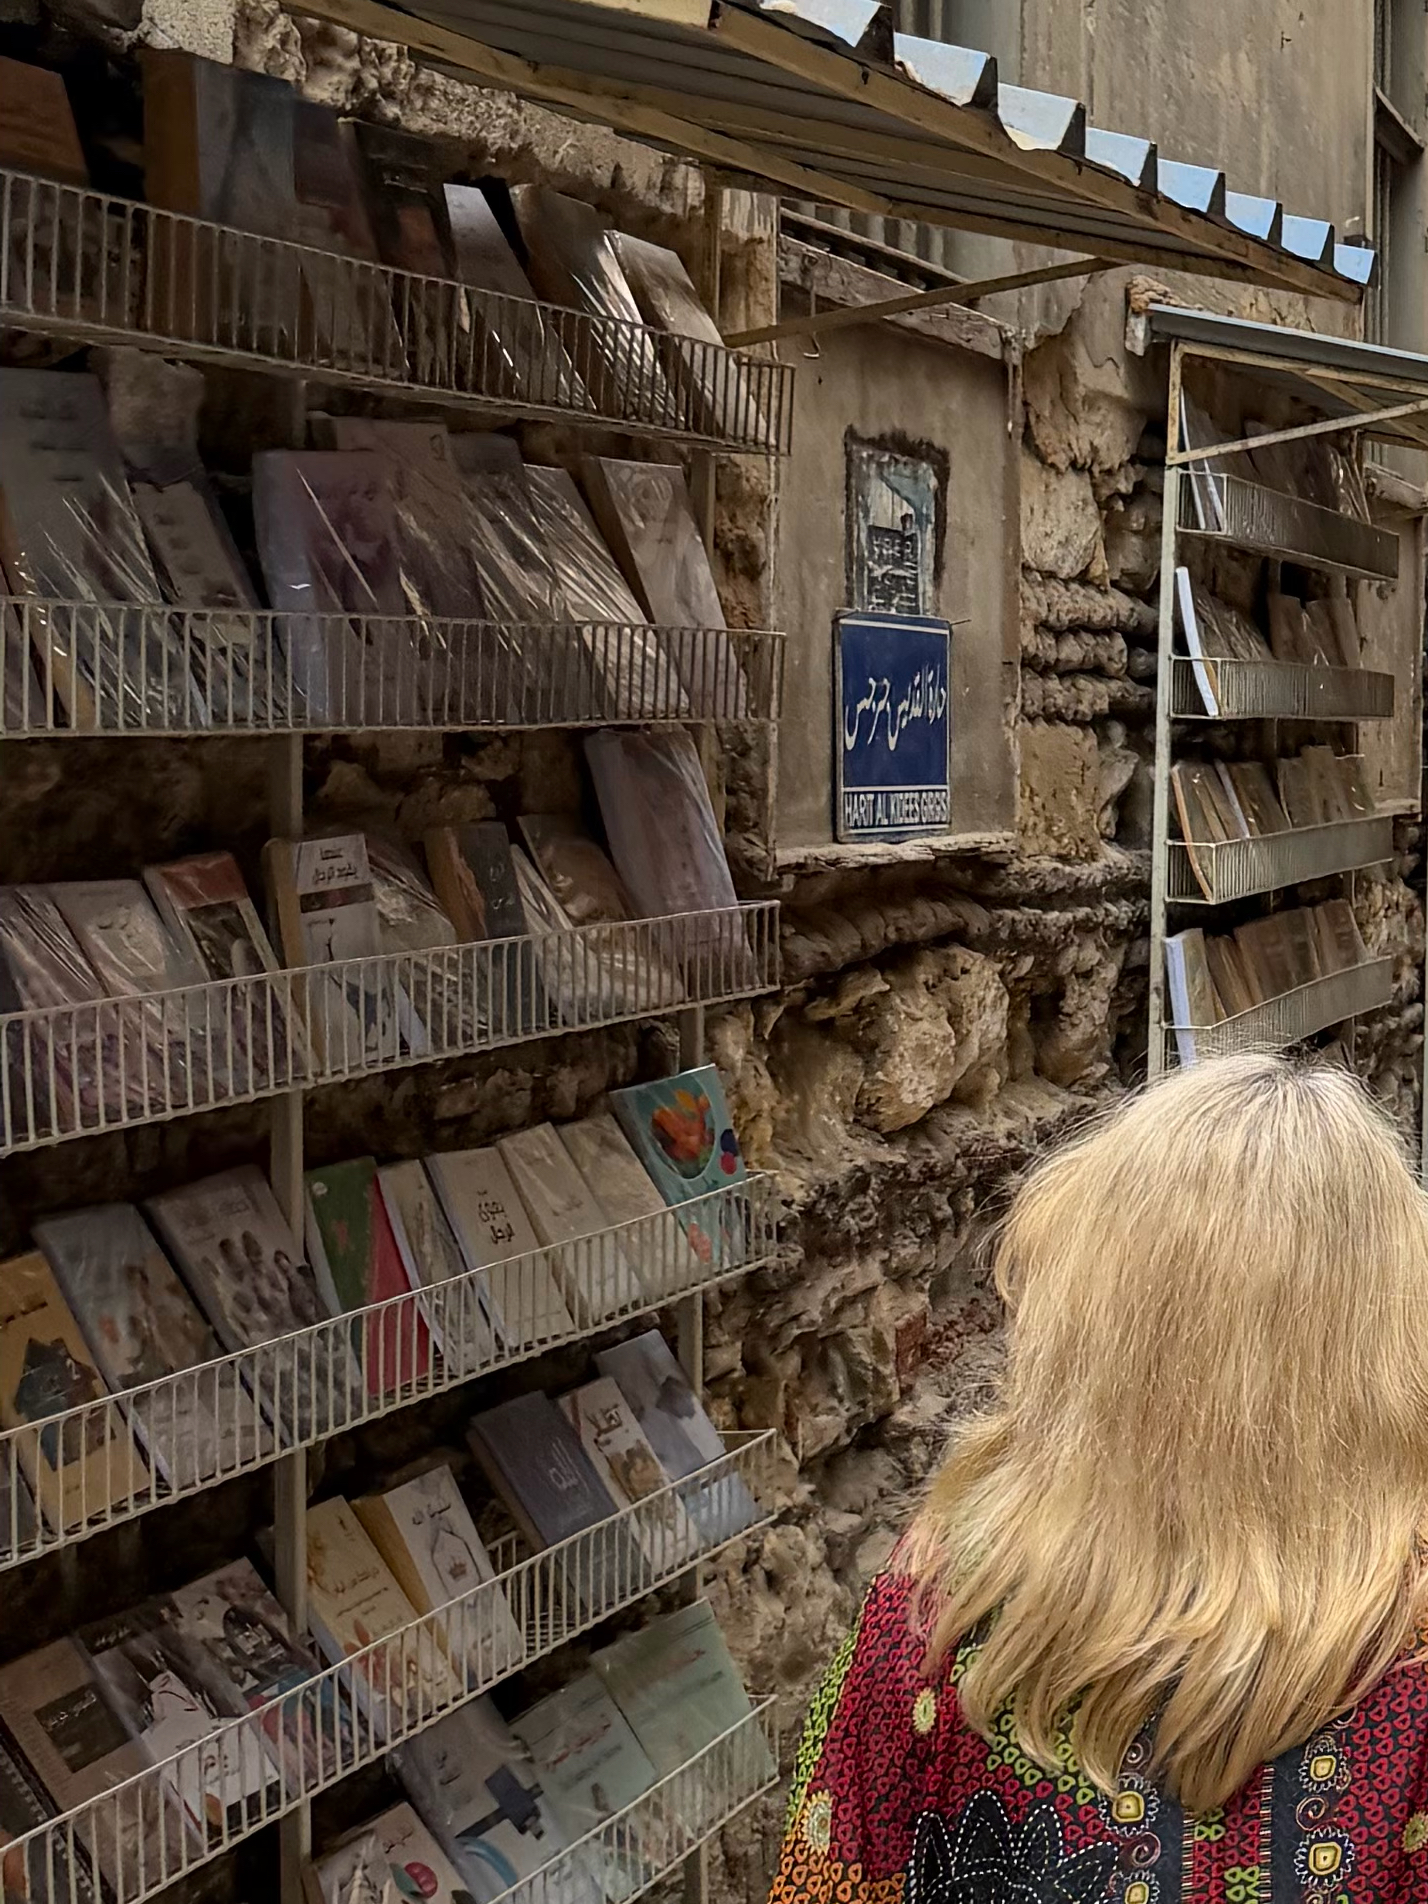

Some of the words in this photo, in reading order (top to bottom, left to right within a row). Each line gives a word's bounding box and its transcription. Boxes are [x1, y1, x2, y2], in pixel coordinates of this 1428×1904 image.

[845, 677, 889, 751] جرجس
[887, 663, 929, 751] القديس
[928, 663, 947, 725] حارة
[875, 793, 888, 827] AL
